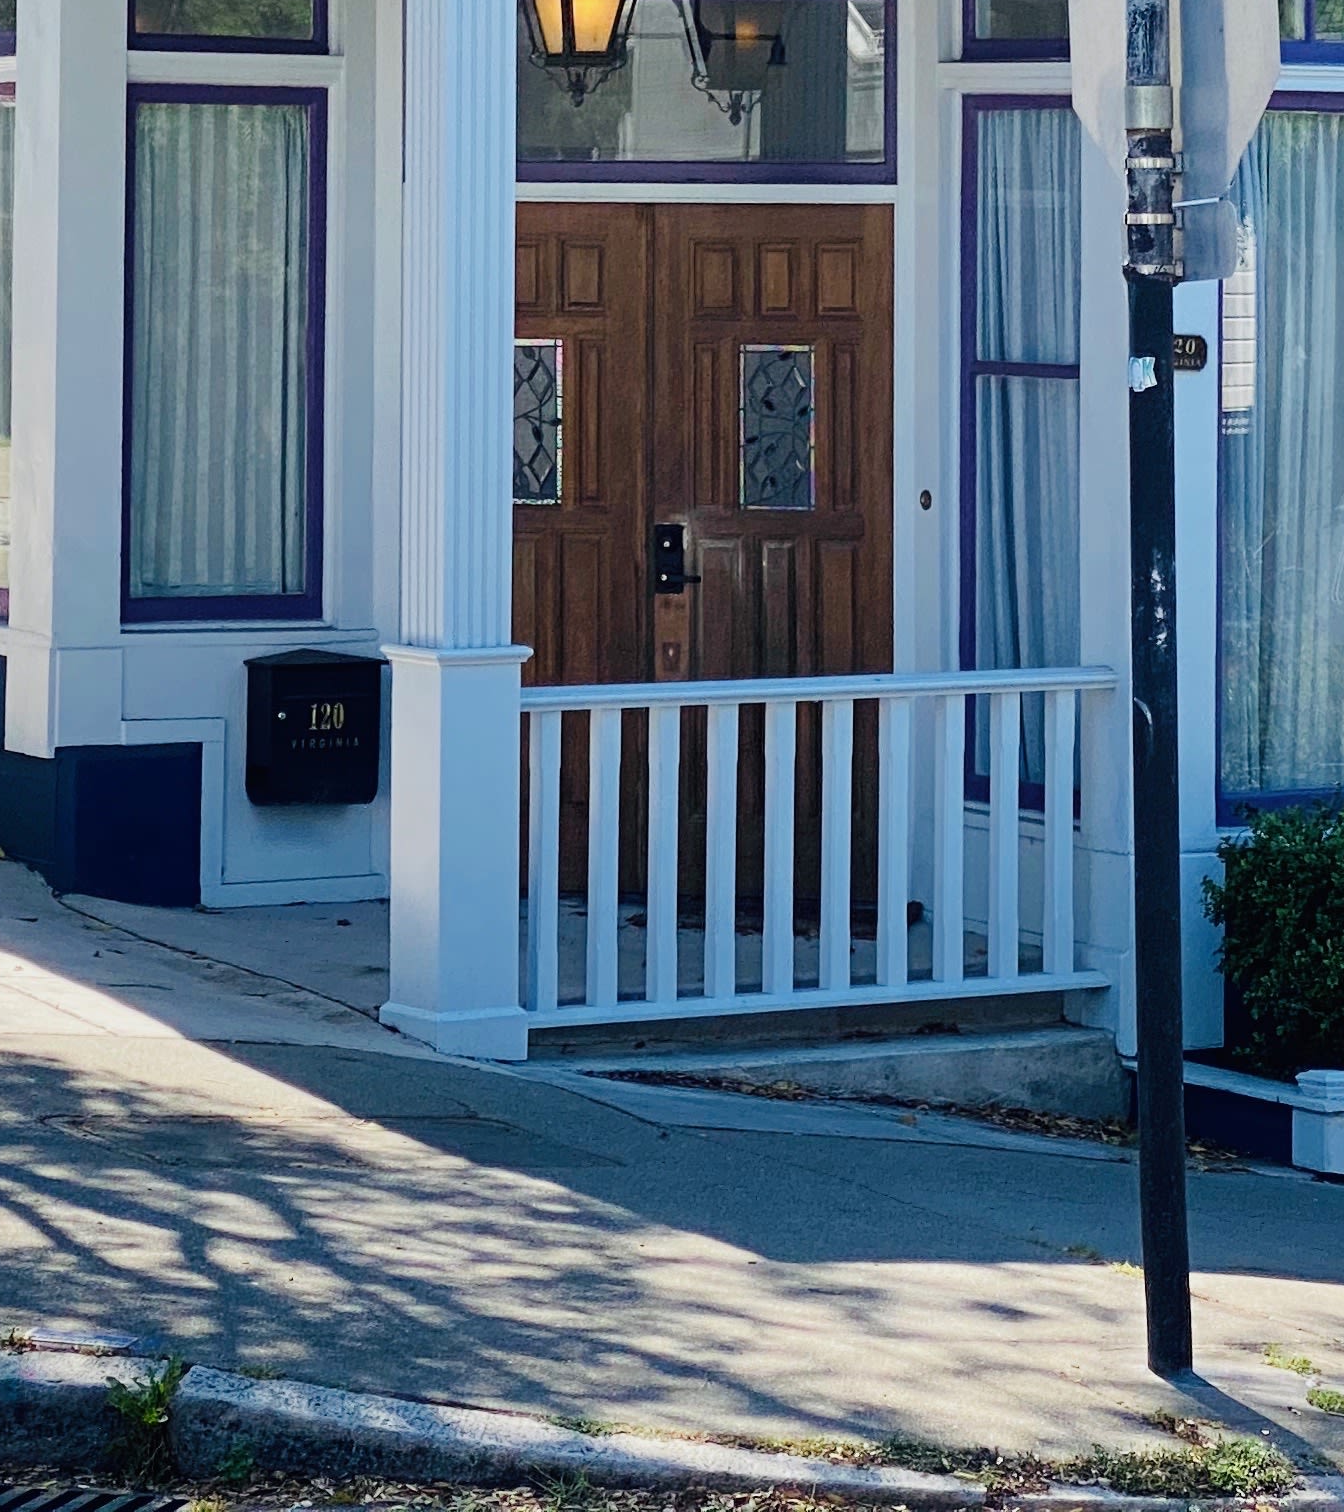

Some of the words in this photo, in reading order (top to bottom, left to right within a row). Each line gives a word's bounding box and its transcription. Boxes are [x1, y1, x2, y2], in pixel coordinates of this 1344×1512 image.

[1174, 338, 1196, 355] 20
[309, 703, 344, 730] 120
[291, 738, 359, 749] VIRGINIA
